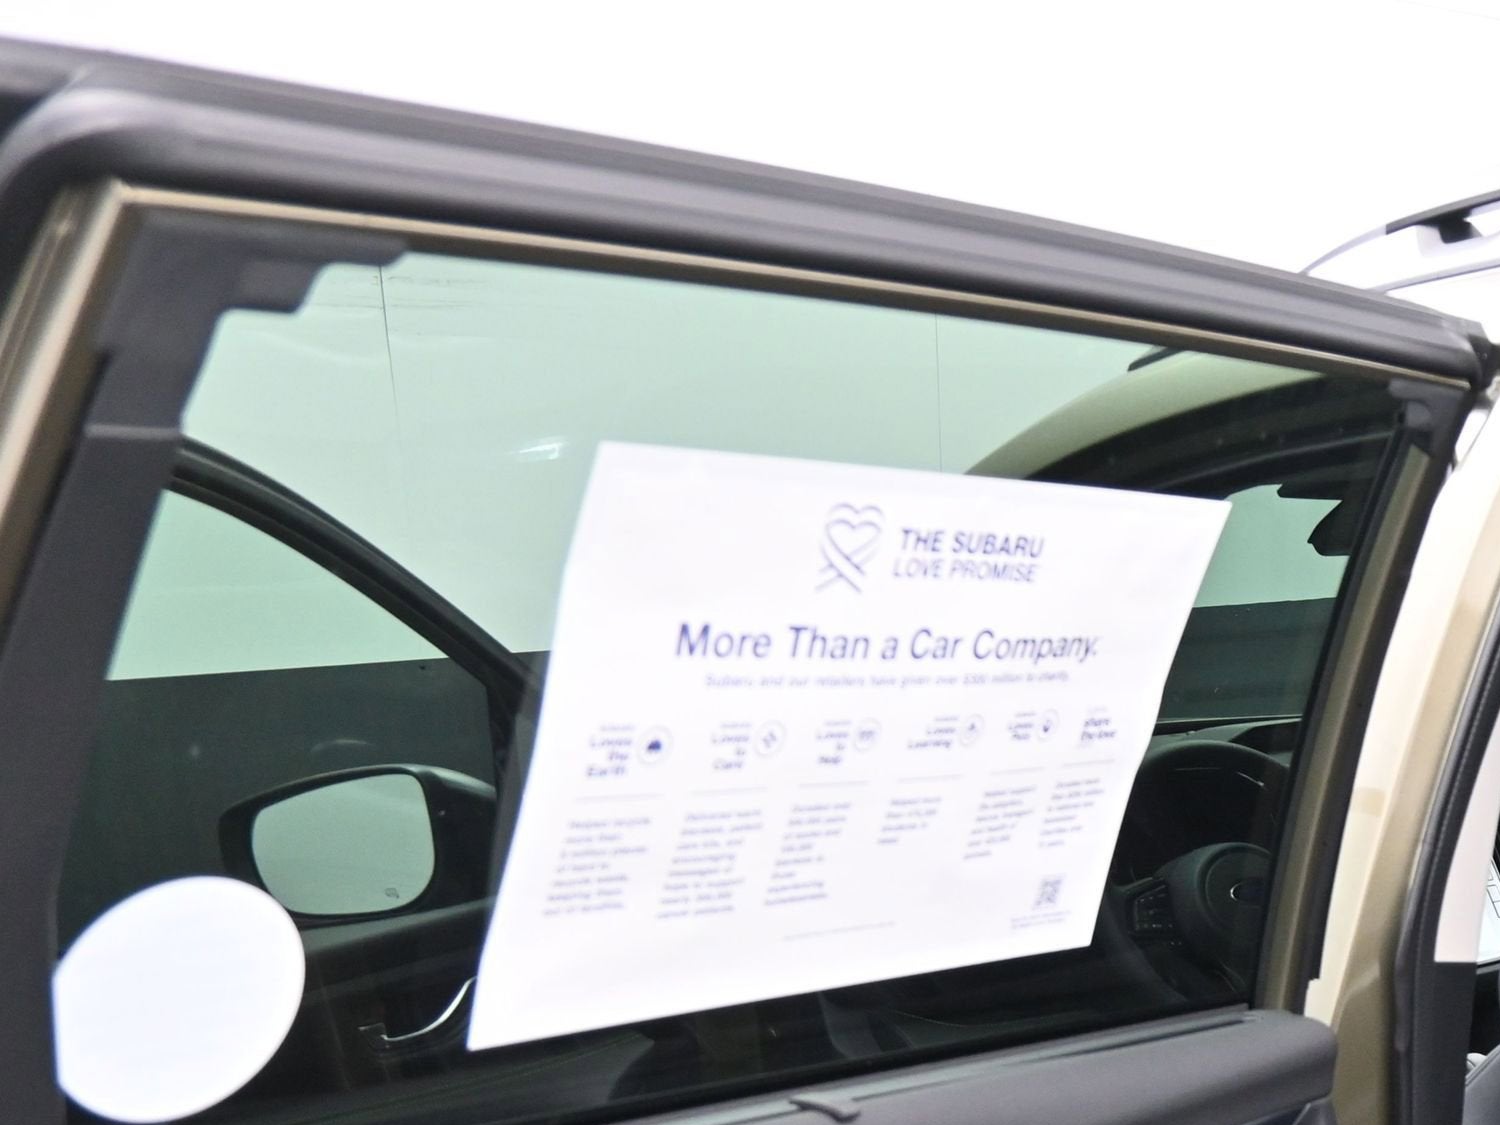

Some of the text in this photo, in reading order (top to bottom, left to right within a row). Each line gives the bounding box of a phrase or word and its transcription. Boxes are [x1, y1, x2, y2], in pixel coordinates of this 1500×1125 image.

[900, 527, 1046, 559] THE SUBARU
[893, 558, 1040, 583] LOVE PROMISE
[675, 621, 772, 660] More
[787, 624, 870, 660] Than
[880, 636, 899, 661] a
[909, 628, 965, 661] Car
